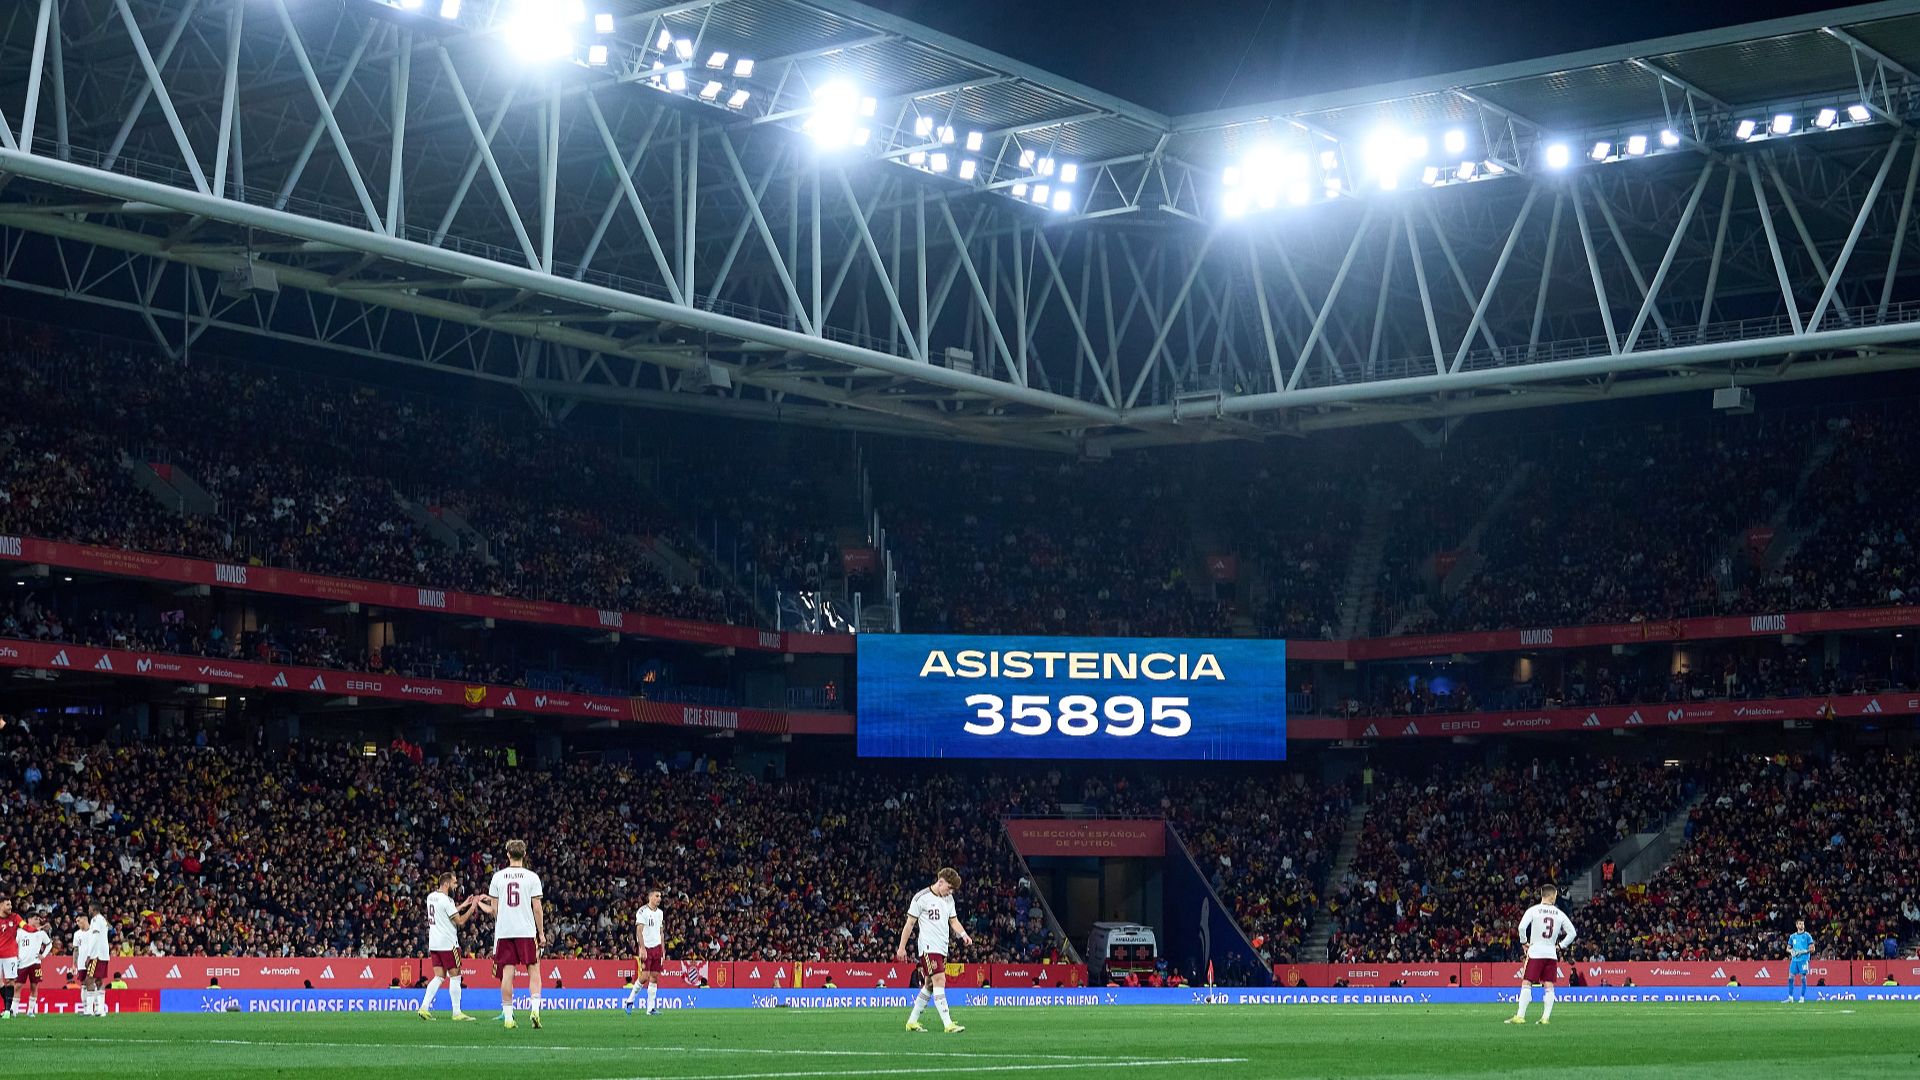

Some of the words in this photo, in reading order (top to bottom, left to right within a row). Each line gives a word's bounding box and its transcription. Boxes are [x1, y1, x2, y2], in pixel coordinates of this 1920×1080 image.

[215, 563, 247, 585] VAMOS
[417, 588, 446, 609] VAMOS
[597, 609, 623, 629] VAMOS
[1750, 614, 1786, 632] VAMOS
[758, 631, 781, 649] VAMOS
[1520, 629, 1553, 646] VAMOS
[154, 661, 182, 671] movistar
[919, 649, 1226, 682] ASISTENCIA
[209, 667, 233, 678] Halcón
[346, 680, 382, 691] EBRO
[412, 685, 443, 695] mapfre
[591, 703, 610, 712] Halcón
[1745, 707, 1772, 716] Halcón
[683, 707, 703, 726] RCDE
[704, 709, 739, 729] STADIUM
[963, 693, 1192, 738] 35895
[1686, 709, 1714, 718] movistar
[1441, 720, 1481, 731] EBRO
[1516, 717, 1551, 727] mapfre
[1055, 839, 1070, 848] DE
[507, 882, 520, 908] 6
[429, 904, 436, 925] 9
[928, 909, 940, 921] 25
[1541, 916, 1555, 939] 3
[21, 938, 31, 947] 20
[11, 962, 16, 972] 7
[206, 967, 240, 977] EBRO
[272, 966, 301, 977] mapfre
[1659, 968, 1681, 977] Halcón
[34, 968, 43, 978] 20
[1010, 970, 1029, 978] mapfre
[1348, 970, 1379, 978] EBRO
[1411, 969, 1440, 978] mapfre
[540, 997, 618, 1010] ENSUCIARSE
[785, 996, 853, 1008] ENSUCIARSE
[855, 996, 867, 1008] ES
[869, 996, 907, 1008] BUENO
[993, 996, 1053, 1006] ENSUCIARSE
[1054, 996, 1065, 1006] ES
[1066, 995, 1099, 1006] BUENO
[1239, 995, 1338, 1004] ENSUCIARSE
[1342, 995, 1360, 1004] ES
[1364, 994, 1414, 1004] BUENO
[249, 999, 344, 1013] ENSUCIARSE
[348, 999, 364, 1012] ES
[368, 999, 420, 1012] BUENO
